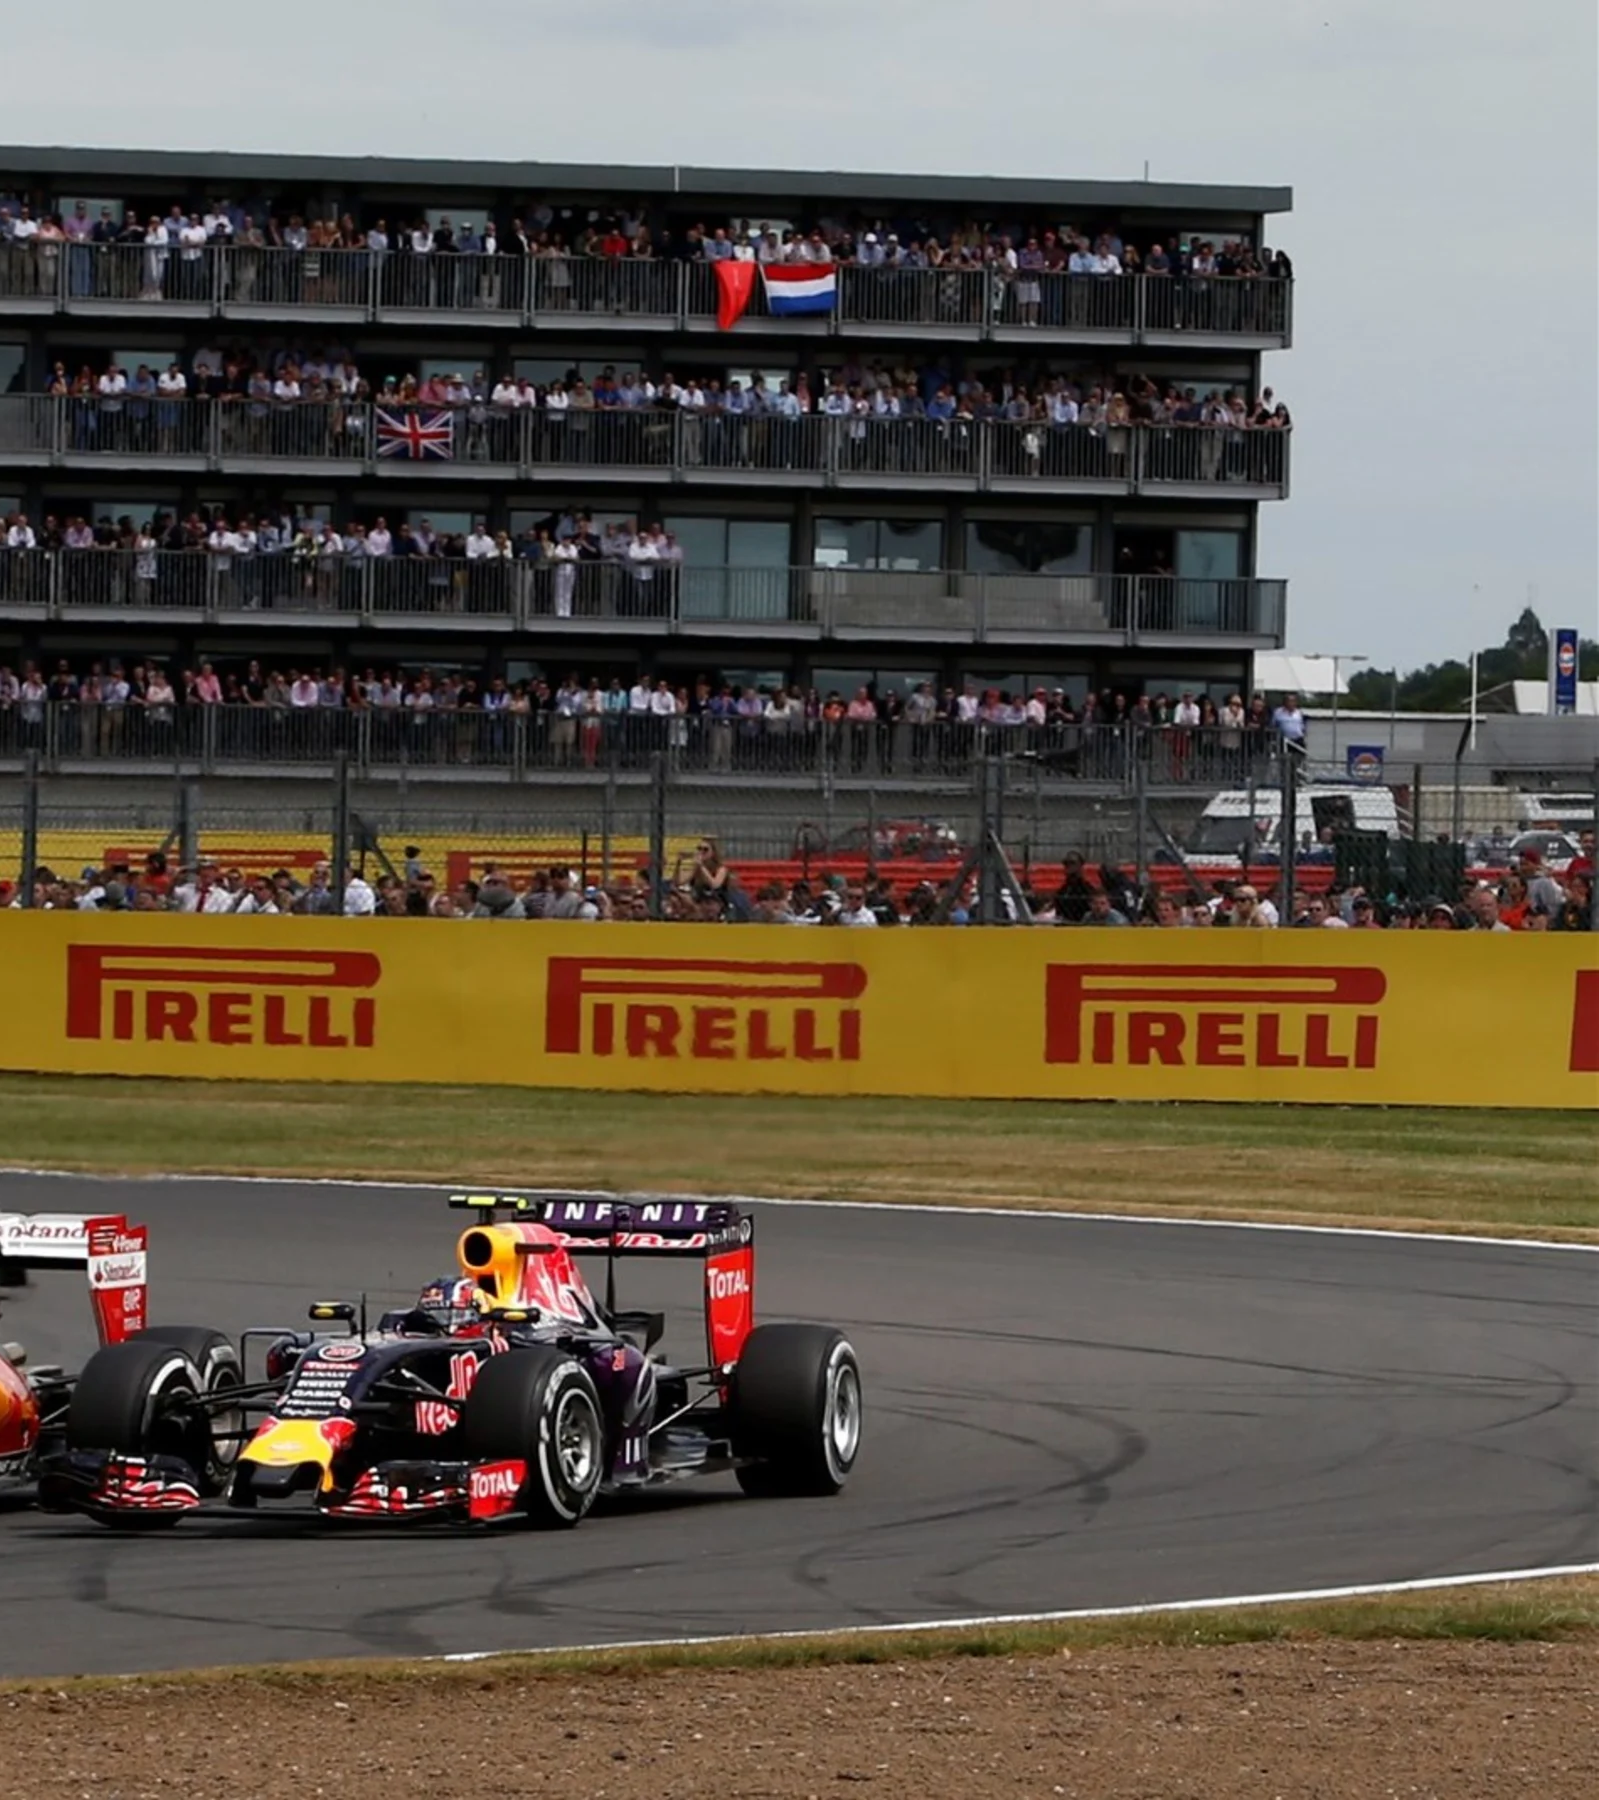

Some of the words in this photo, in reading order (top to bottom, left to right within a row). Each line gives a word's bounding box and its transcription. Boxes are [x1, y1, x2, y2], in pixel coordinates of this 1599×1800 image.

[66, 944, 381, 1047] PIRELLI
[546, 957, 867, 1060] PIRELLI
[1045, 964, 1386, 1068] PIRELLI
[708, 1267, 749, 1299] TOTAL
[471, 1469, 519, 1498] TOTAL
